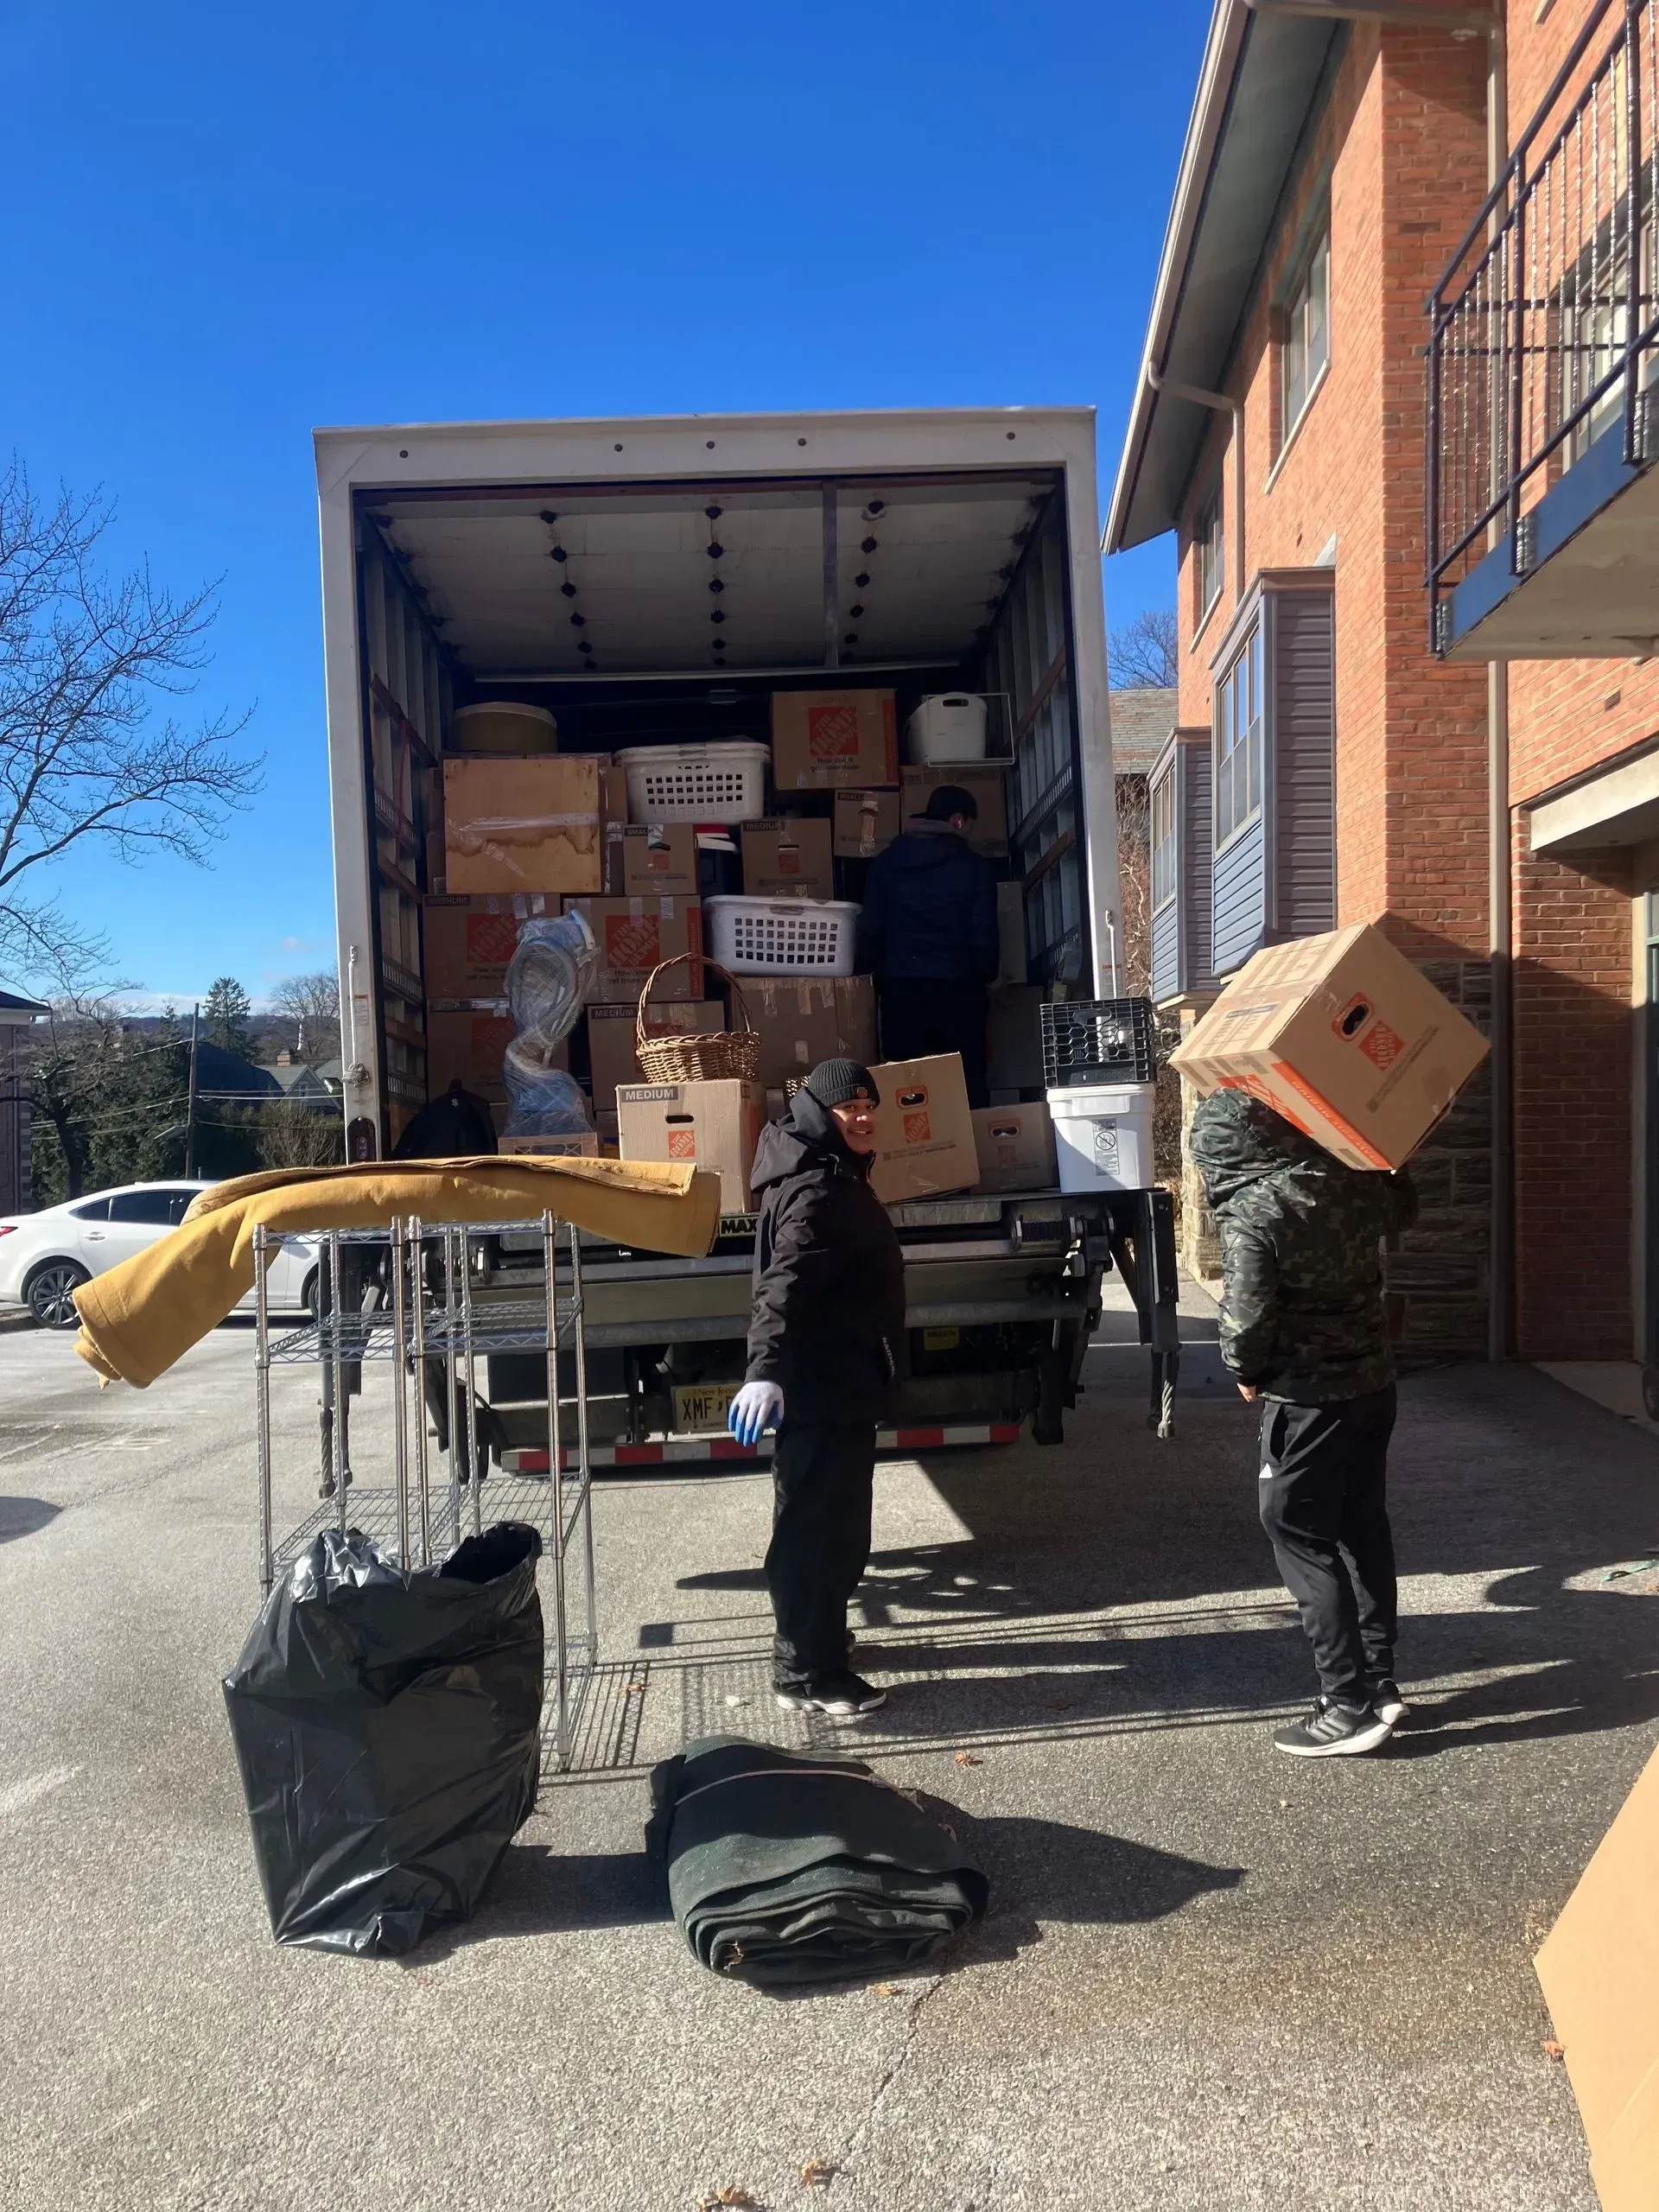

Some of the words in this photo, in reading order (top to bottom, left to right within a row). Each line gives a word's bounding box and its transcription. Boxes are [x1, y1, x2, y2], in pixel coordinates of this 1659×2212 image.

[811, 706, 857, 756] HOME
[814, 711, 834, 732] THE
[830, 724, 860, 754] DEPOT
[428, 896, 467, 905] MEDIUM
[468, 913, 517, 963] HOME
[607, 915, 660, 968] HOME
[627, 935, 660, 967] DEPOT
[594, 1008, 634, 1018] MEDIUM
[625, 1088, 675, 1101] MEDIUM
[1291, 1079, 1333, 1122] MEDIUM
[669, 1129, 696, 1159] HOME
[682, 1396, 714, 1421] XMF
